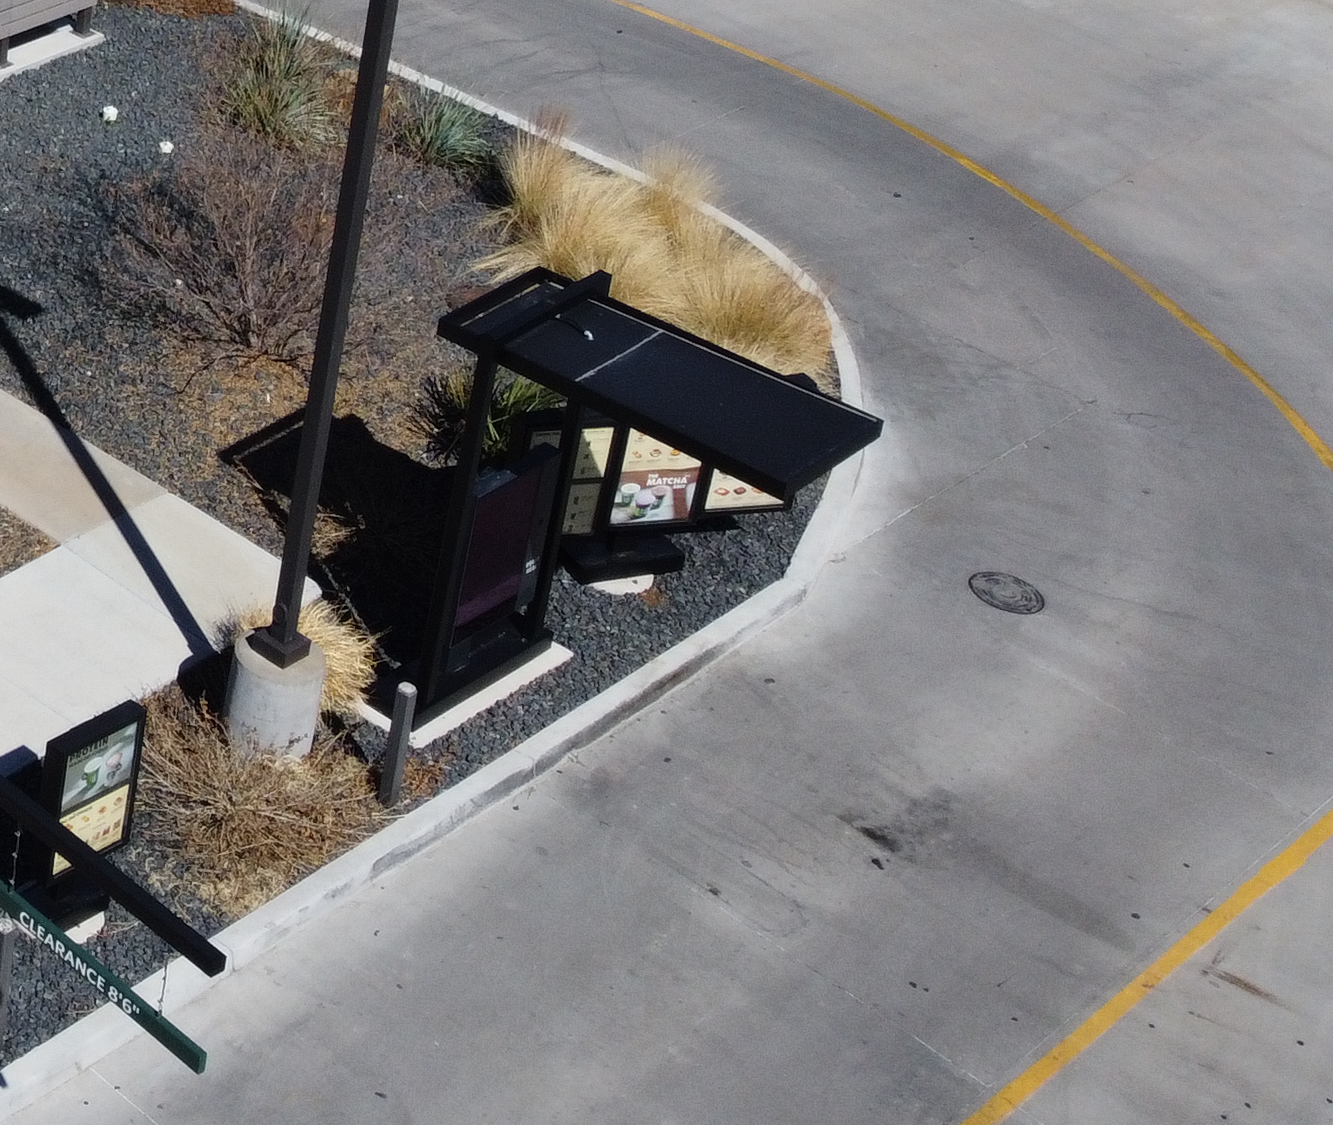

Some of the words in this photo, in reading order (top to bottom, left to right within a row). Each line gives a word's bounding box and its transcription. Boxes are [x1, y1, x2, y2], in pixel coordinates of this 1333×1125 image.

[646, 477, 687, 486] MATCHA
[19, 911, 105, 993] CLEARANCE
[108, 985, 140, 1015] 8'6"
